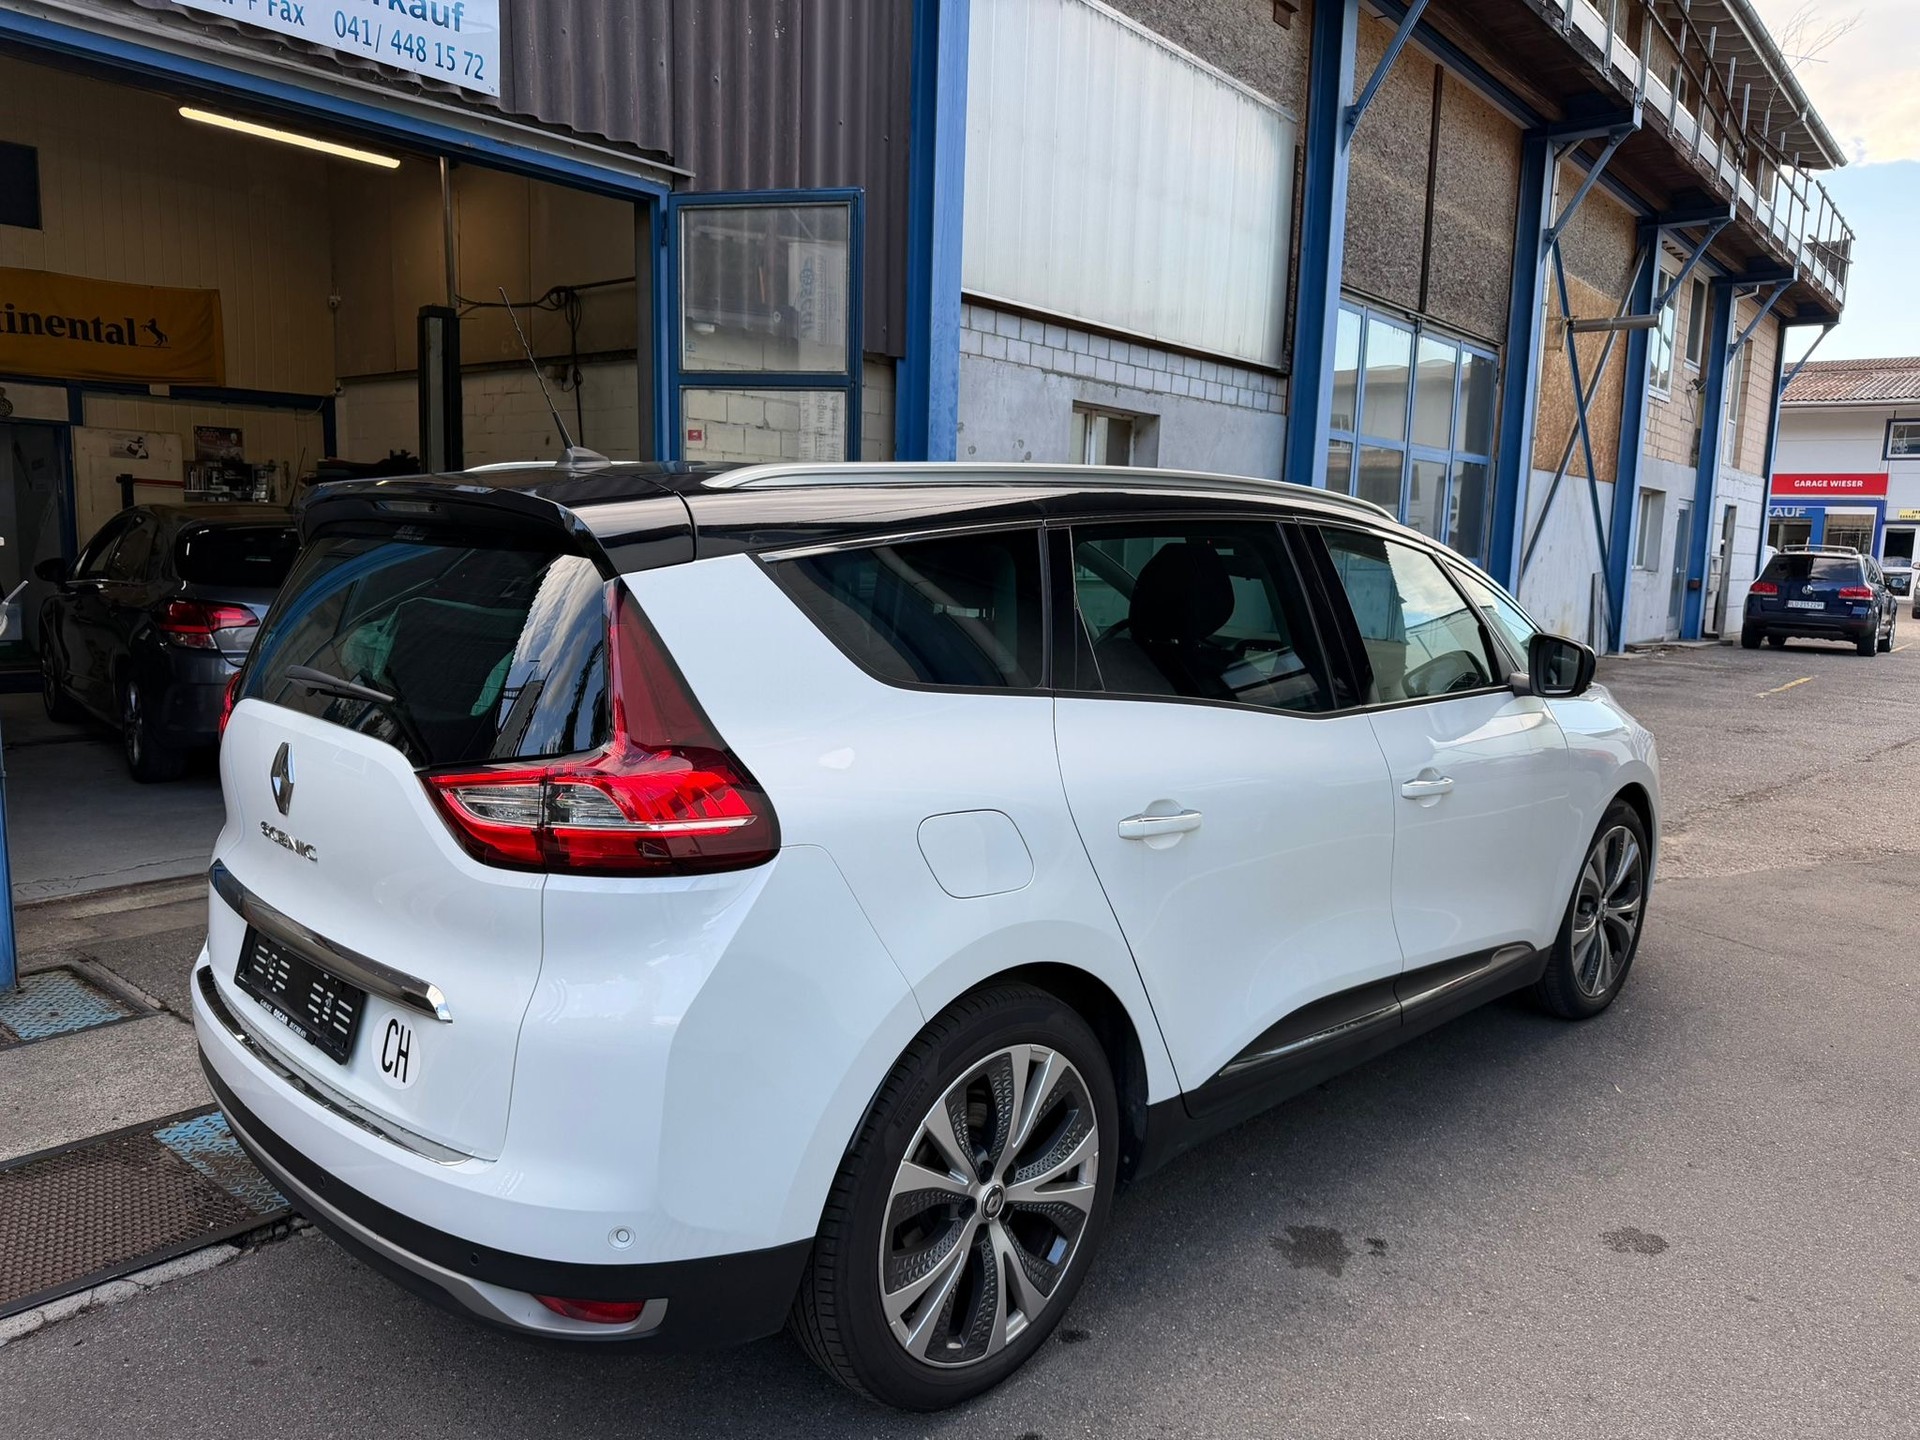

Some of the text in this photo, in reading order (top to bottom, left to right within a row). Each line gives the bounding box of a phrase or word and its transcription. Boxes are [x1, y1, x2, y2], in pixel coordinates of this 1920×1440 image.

[334, 10, 382, 53] 041/
[391, 29, 427, 63] 448
[435, 42, 456, 71] 15
[463, 50, 485, 80] 72
[260, 820, 317, 862] SCENIC
[382, 1018, 411, 1083] CH
